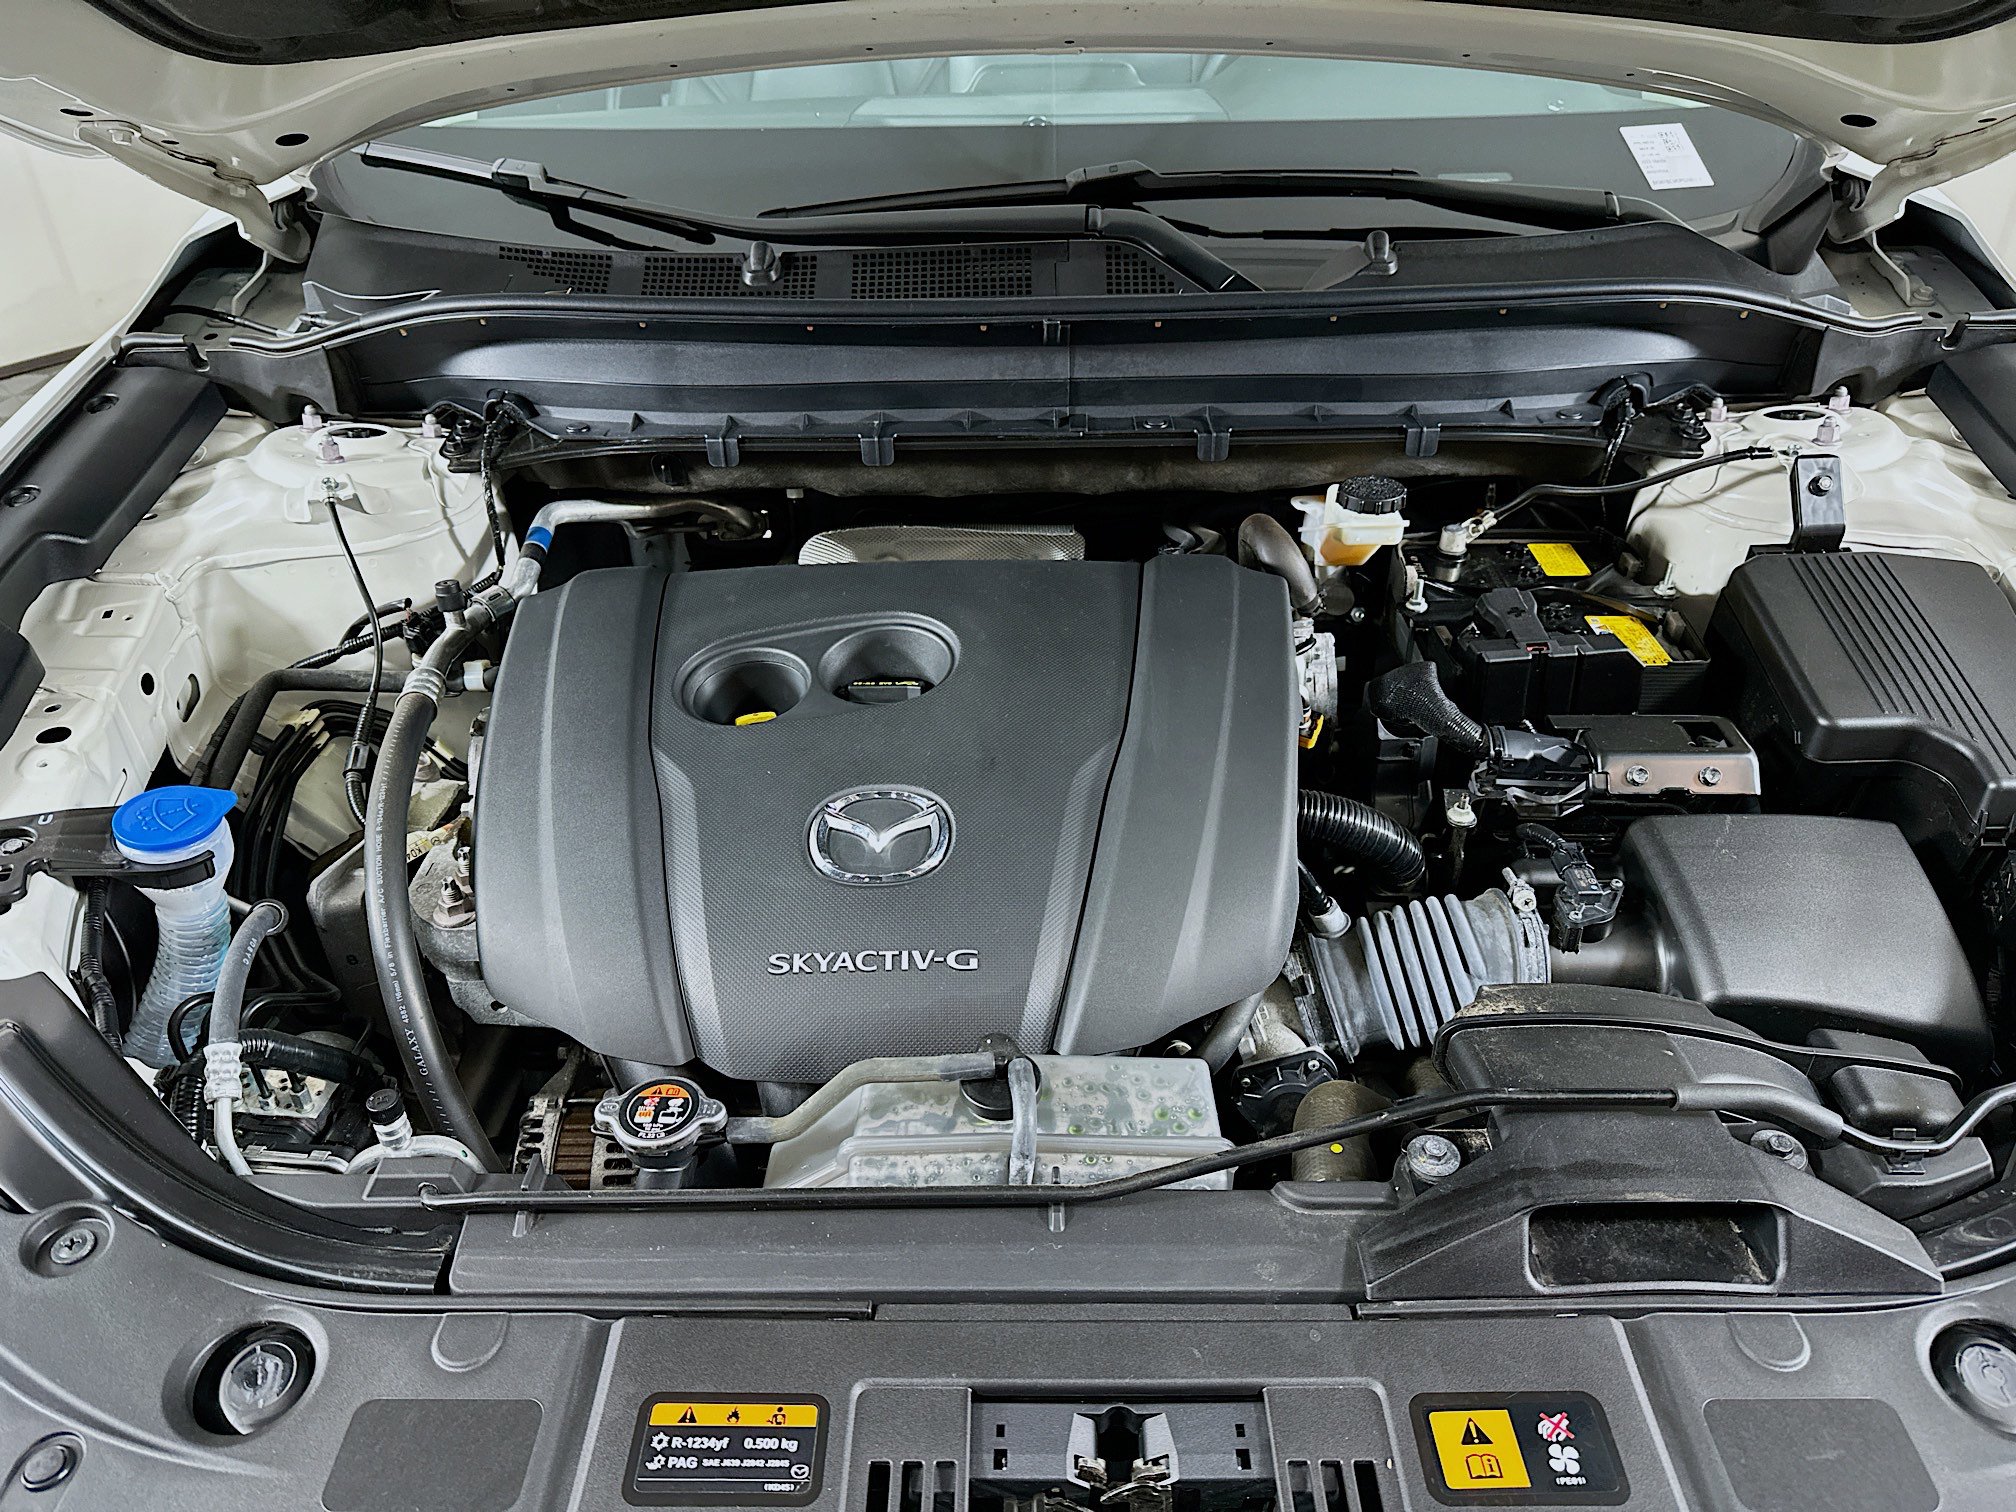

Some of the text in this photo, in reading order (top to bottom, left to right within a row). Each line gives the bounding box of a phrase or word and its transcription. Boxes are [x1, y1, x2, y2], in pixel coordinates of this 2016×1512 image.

[375, 854, 384, 885] SUCTION
[377, 888, 386, 904] A/C
[767, 949, 979, 975] SKYACTIV-G
[404, 1028, 429, 1076] GALAXY
[671, 1436, 799, 1453] R-1234yf 0.500 kg
[667, 1456, 699, 1469] PAG
[702, 1458, 721, 1468] SAE
